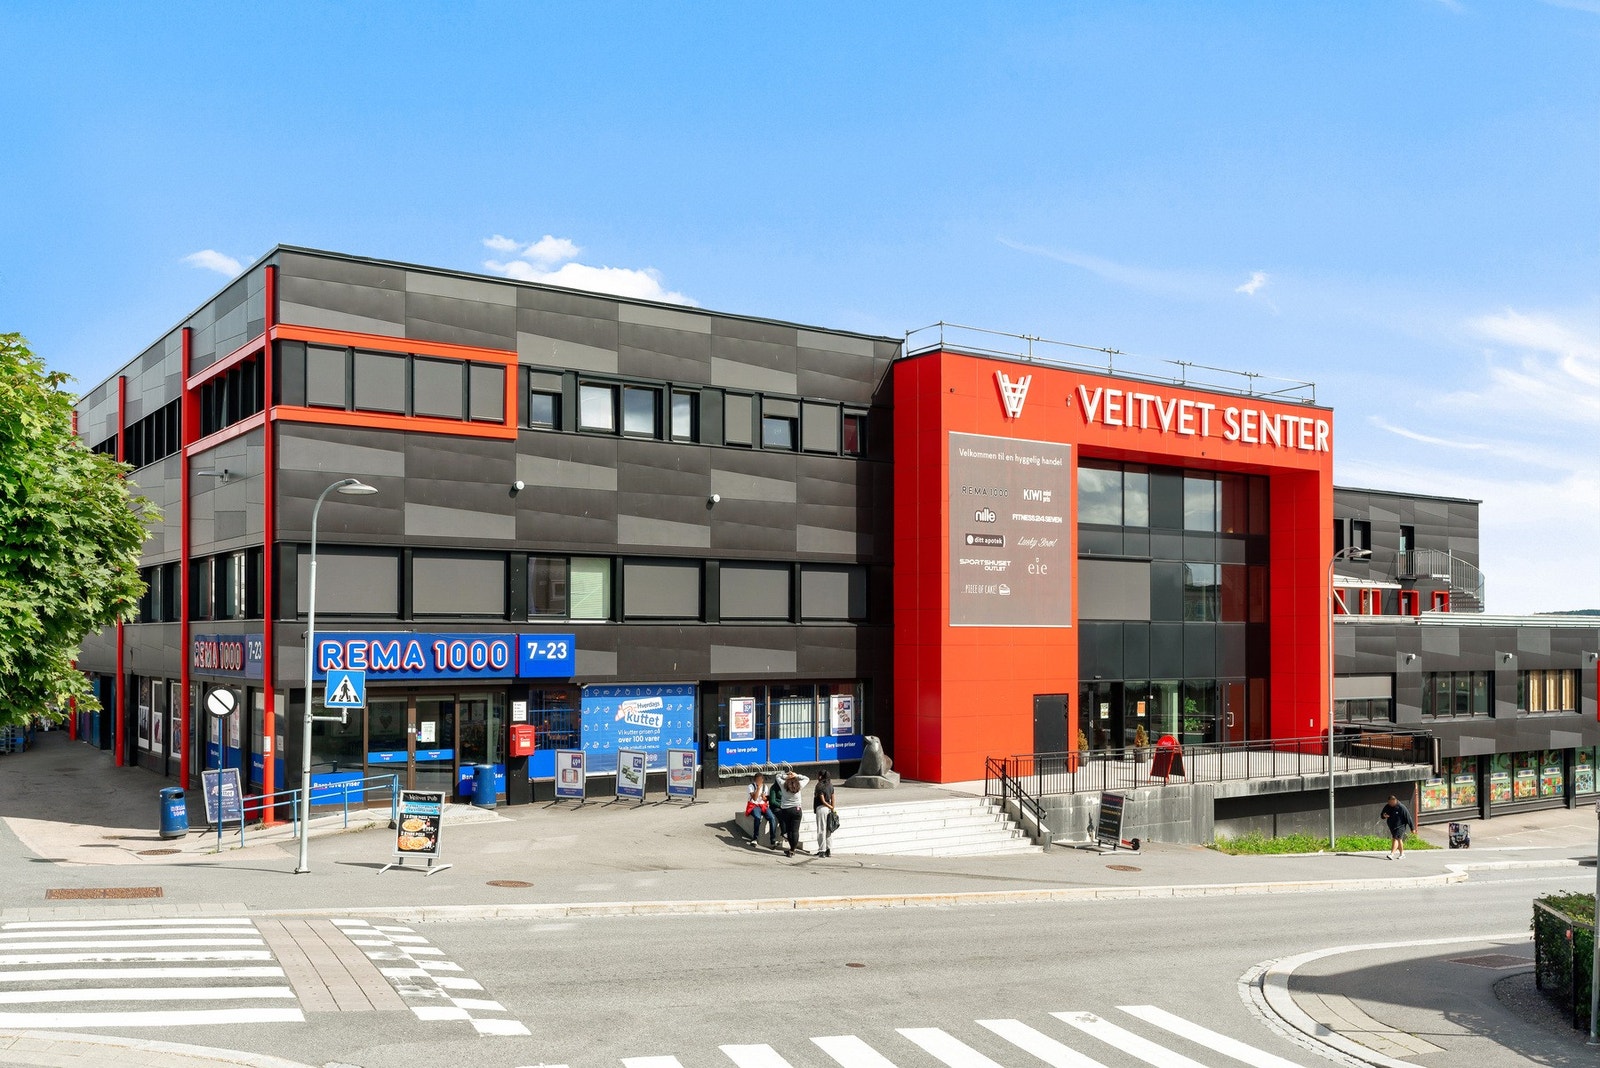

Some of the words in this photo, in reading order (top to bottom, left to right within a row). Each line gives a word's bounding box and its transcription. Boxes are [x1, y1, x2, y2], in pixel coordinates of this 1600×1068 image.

[1078, 384, 1215, 437] VEITVET
[1223, 407, 1330, 452] SENTER
[959, 448, 997, 460] Velkommen
[1015, 454, 1041, 466] hyggelig
[1041, 456, 1062, 466] handel
[962, 486, 987, 495] REMA
[990, 488, 1008, 498] 1000
[1023, 488, 1042, 501] KIWI
[975, 507, 996, 522] nille
[194, 641, 218, 668] REMA
[220, 642, 243, 670] 1000
[248, 641, 262, 660] 7-23
[318, 640, 426, 670] REMA
[432, 640, 508, 670] 1000
[527, 642, 568, 659] 7-23
[627, 712, 659, 726] kuttet
